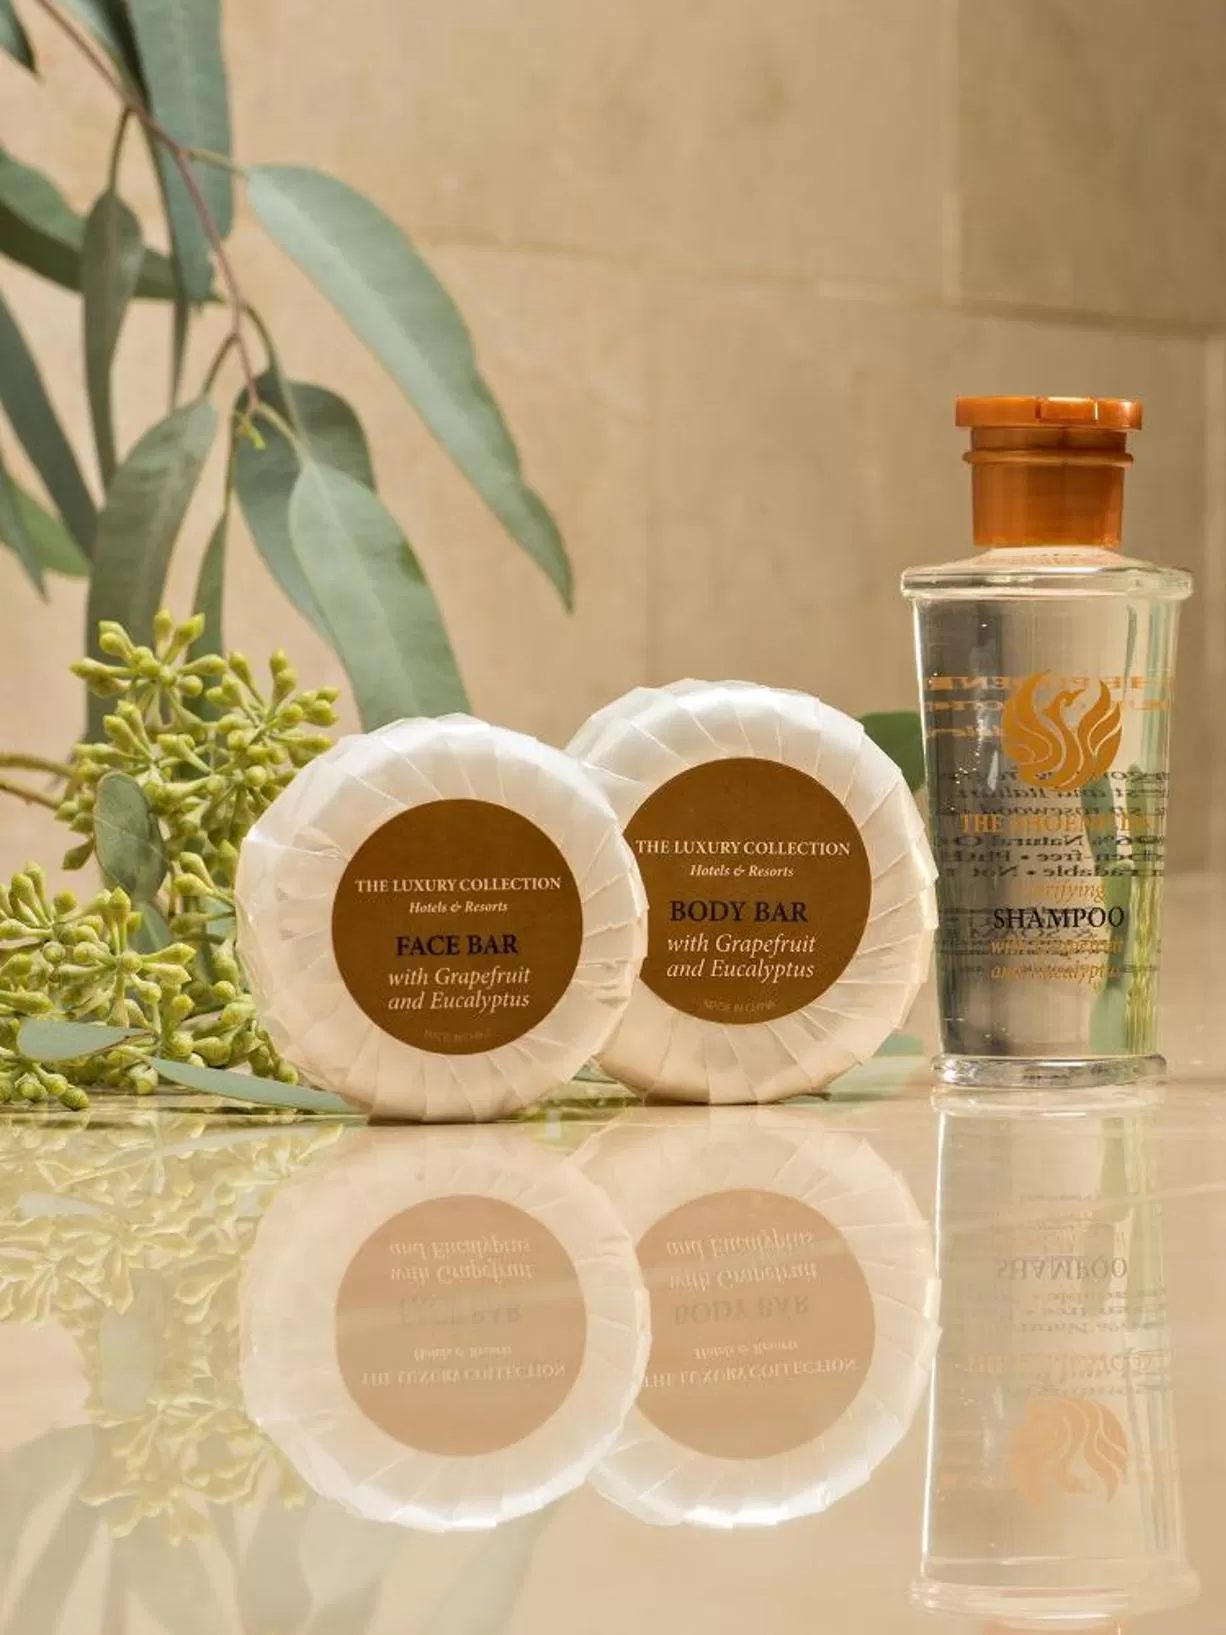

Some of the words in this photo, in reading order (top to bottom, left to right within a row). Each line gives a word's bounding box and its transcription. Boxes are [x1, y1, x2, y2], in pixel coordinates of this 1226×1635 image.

[960, 813, 1001, 833] THE
[635, 839, 670, 854] THE
[674, 840, 741, 855] LUXURY
[743, 841, 851, 856] COLLECTION
[690, 864, 730, 877] Hotels
[733, 866, 745, 877] &
[749, 865, 794, 878] Resorts
[355, 878, 389, 893] THE
[393, 878, 457, 892] LUXURY
[460, 876, 561, 891] COLLECTION
[409, 902, 447, 914] Hotels
[450, 903, 462, 912] &
[465, 900, 508, 912] Resorts
[670, 900, 746, 922] BODY
[754, 902, 809, 923] BAR
[993, 906, 1125, 929] SHAMPOO
[395, 935, 460, 957] FACE
[467, 934, 519, 955] BAR
[667, 933, 709, 953] with
[715, 933, 816, 959] Grapefruit
[388, 968, 429, 986] with
[435, 965, 531, 990] Grapefruit
[666, 959, 704, 978] and
[710, 959, 815, 984] Eucalyptus
[388, 992, 424, 1011] and
[430, 990, 530, 1013] Eucalyptus
